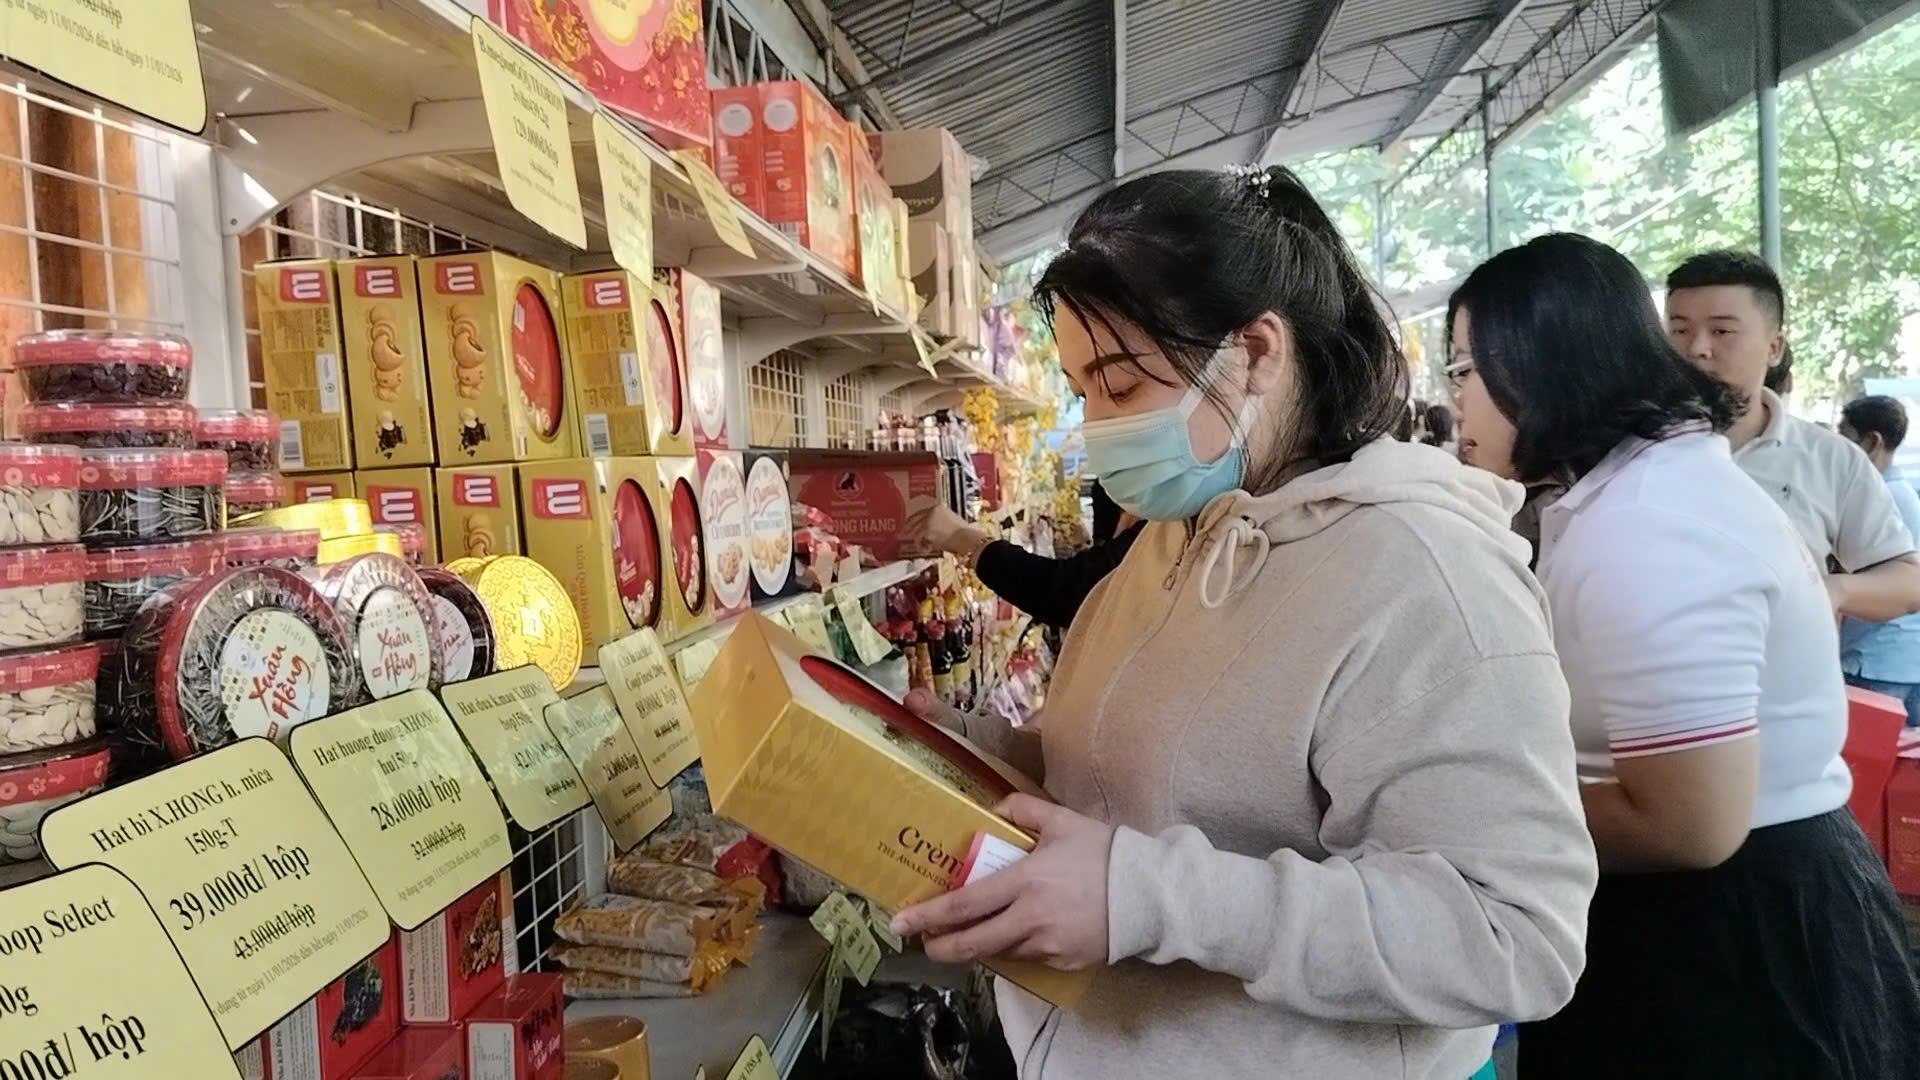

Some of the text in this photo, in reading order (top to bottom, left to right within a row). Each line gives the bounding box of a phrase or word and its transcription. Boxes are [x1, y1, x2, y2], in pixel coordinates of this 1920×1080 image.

[313, 746, 342, 766] Hat
[338, 735, 376, 754] huong
[90, 767, 274, 852] Hat bi X.HONG h. mica
[370, 774, 462, 831] 28.000đ/ hộp
[184, 816, 239, 854] 150g-T
[170, 844, 310, 930] 39.000đ/ hộp
[44, 896, 116, 938] Select
[233, 904, 316, 960] 43.000đ/hộp
[0, 984, 38, 1017] 0g
[77, 1013, 147, 1062] hộp
